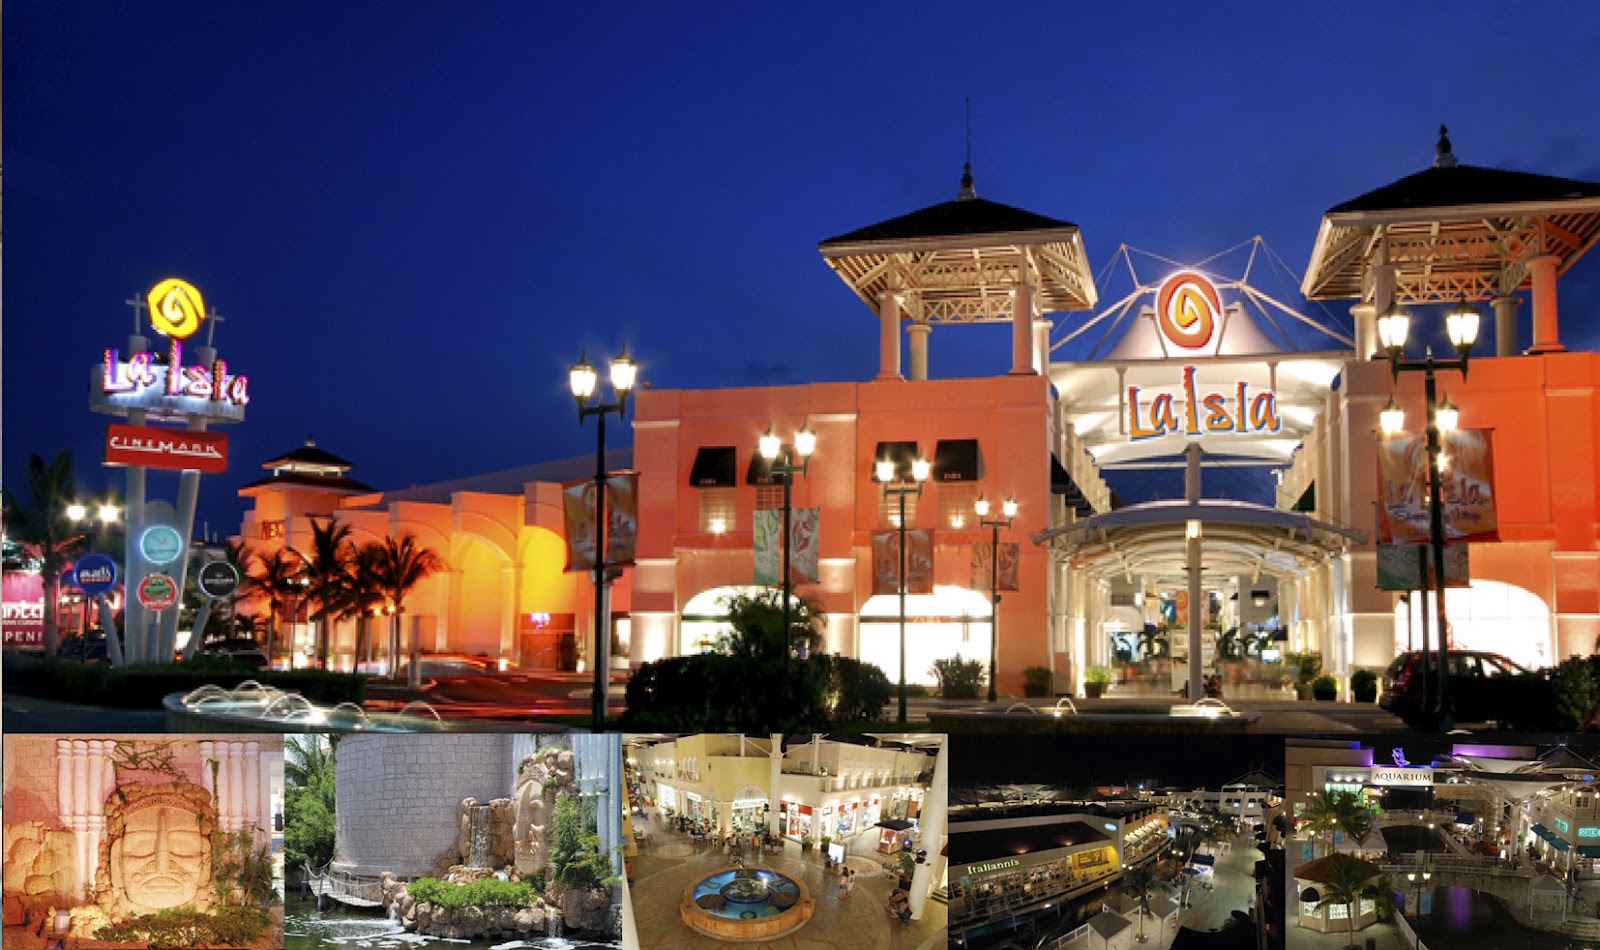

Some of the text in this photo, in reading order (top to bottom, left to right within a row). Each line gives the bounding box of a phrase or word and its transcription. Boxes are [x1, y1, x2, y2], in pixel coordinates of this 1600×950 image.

[103, 337, 250, 406] La Isla
[1128, 365, 1281, 442] La Isla
[5, 631, 43, 642] PEN!
[1374, 772, 1432, 782] AQUARIUM
[967, 859, 1020, 875] Italianni's
